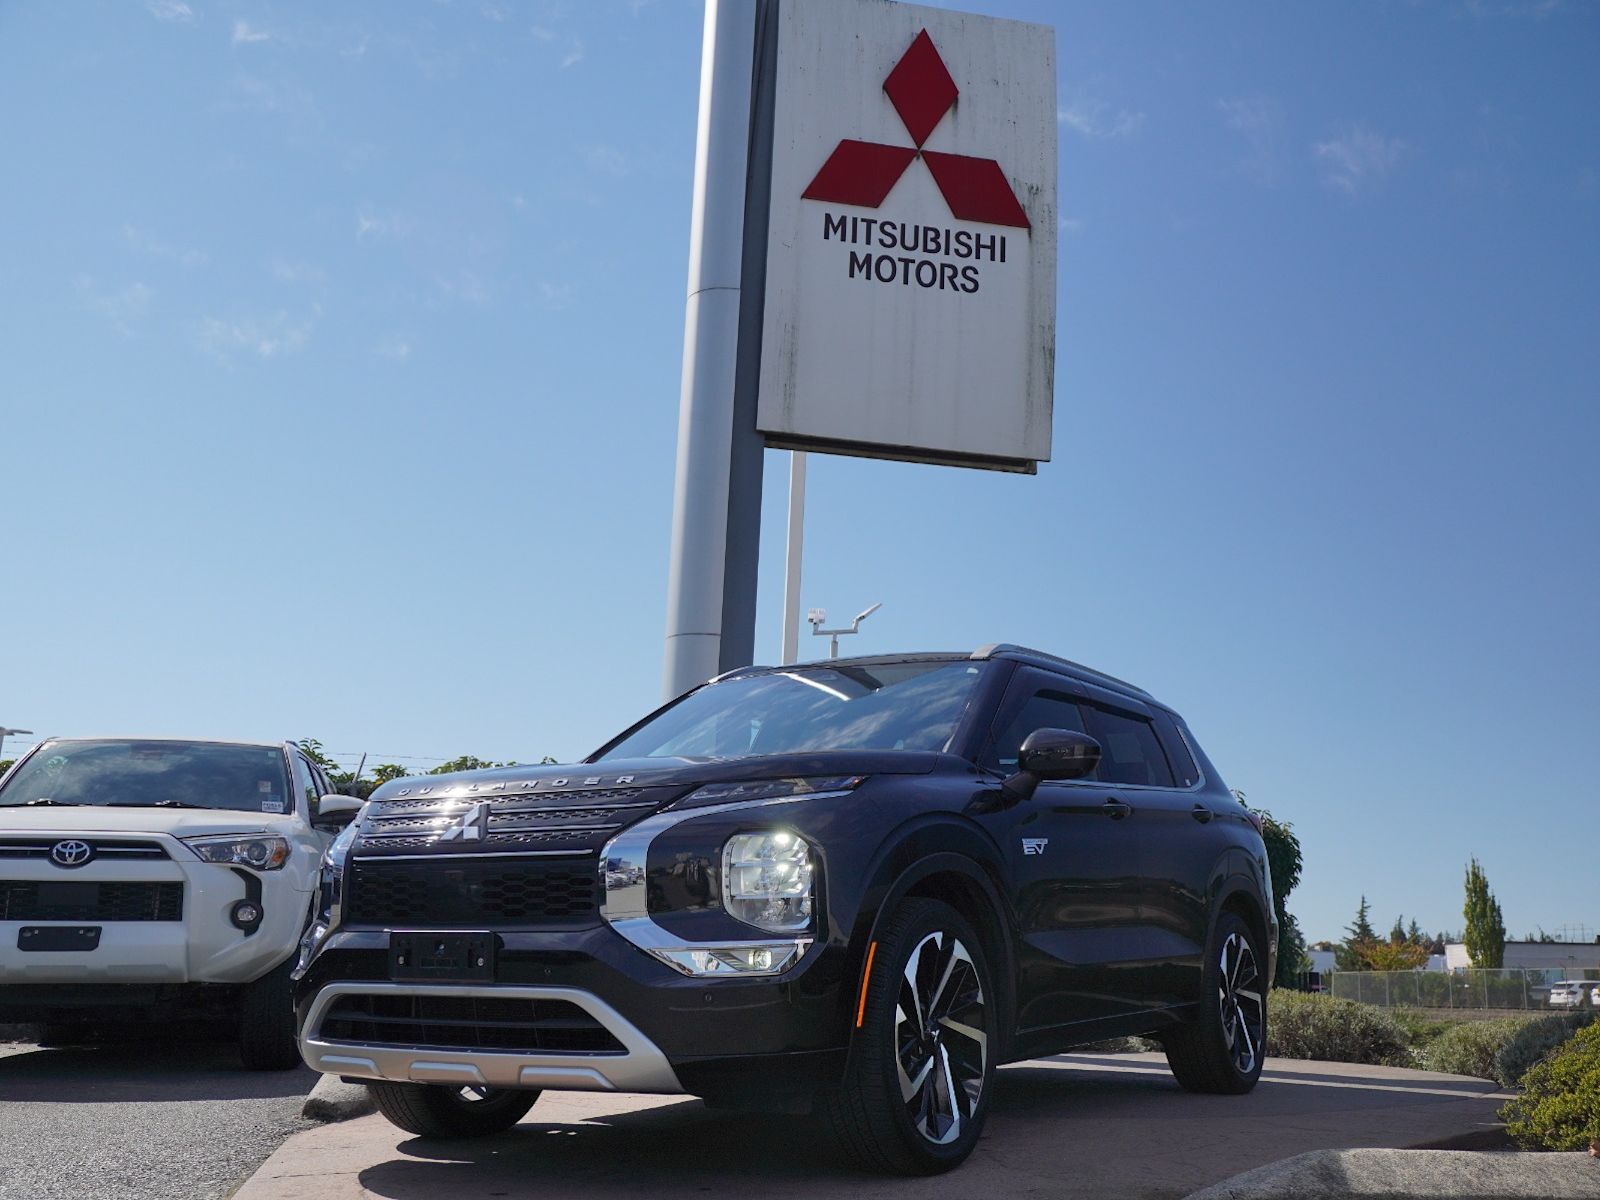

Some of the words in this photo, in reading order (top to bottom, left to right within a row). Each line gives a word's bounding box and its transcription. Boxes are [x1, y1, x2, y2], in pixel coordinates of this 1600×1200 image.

[823, 213, 1006, 263] MITSUBISHI
[849, 250, 979, 293] MOTORS
[1022, 840, 1047, 855] EV
